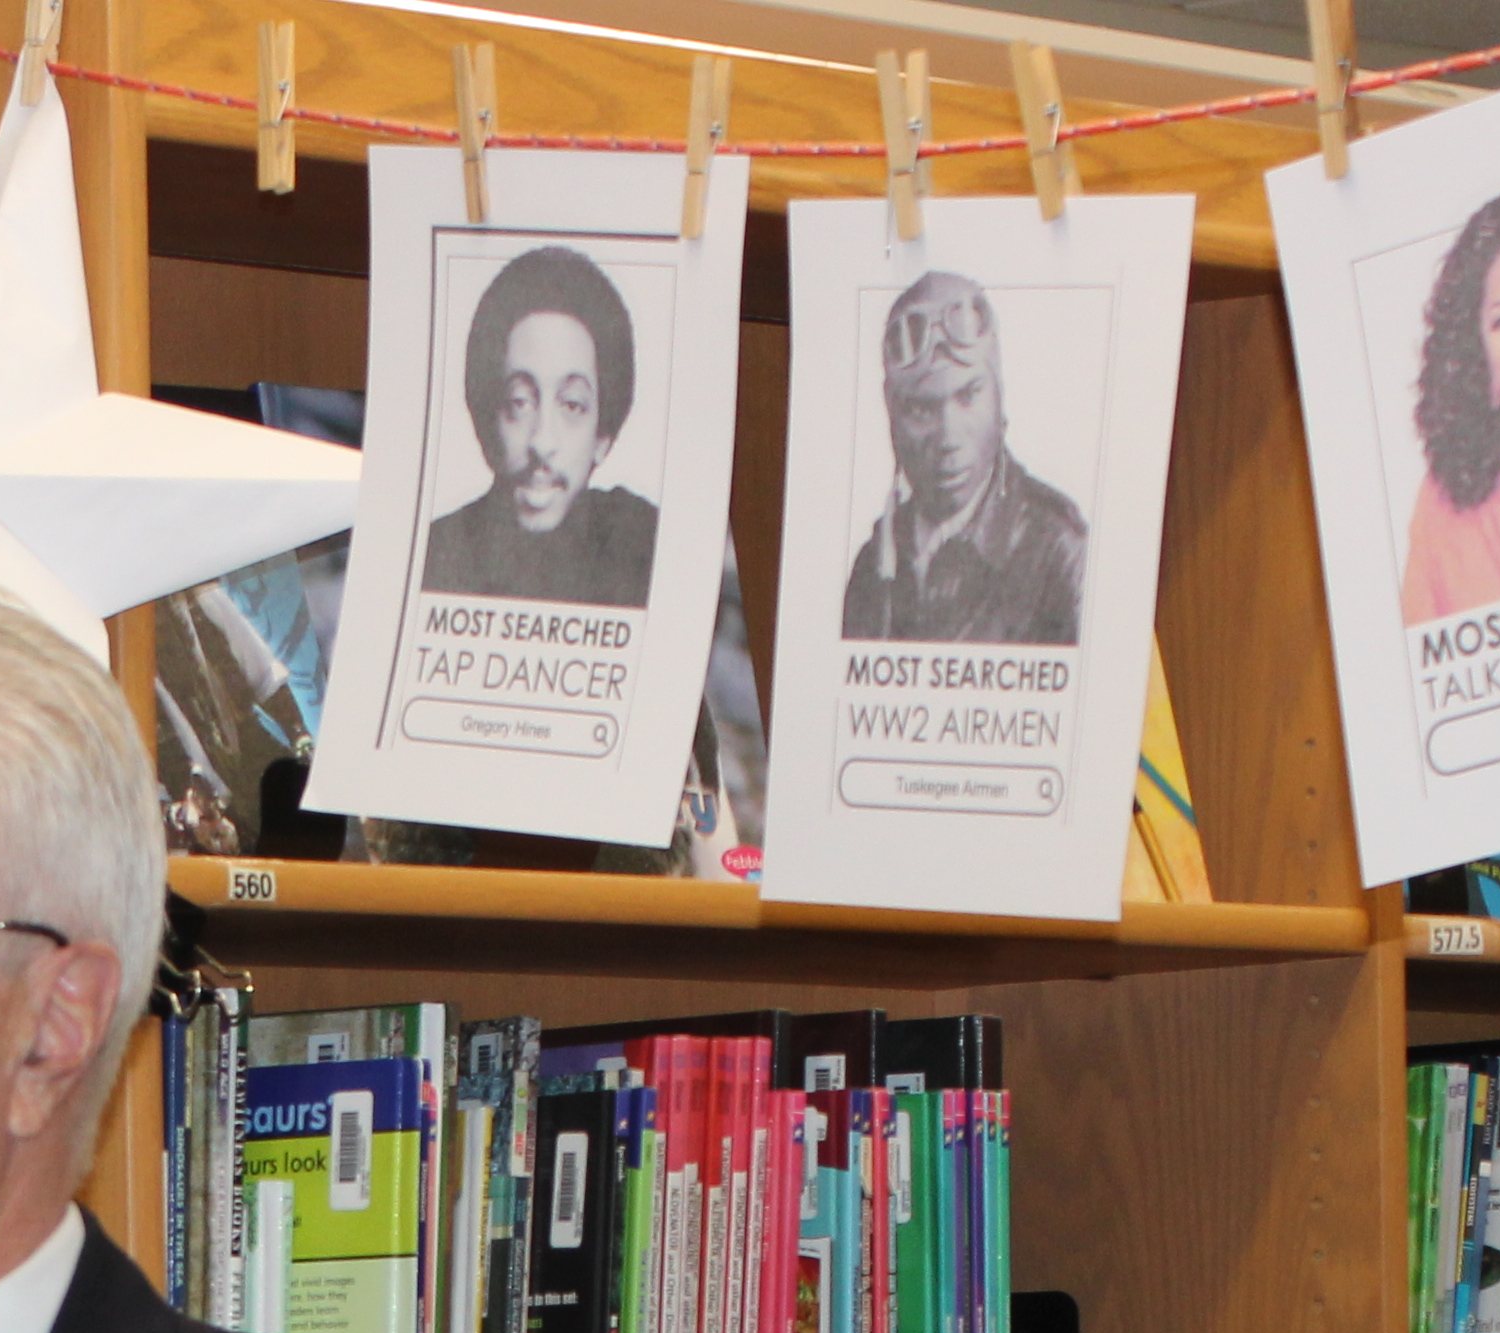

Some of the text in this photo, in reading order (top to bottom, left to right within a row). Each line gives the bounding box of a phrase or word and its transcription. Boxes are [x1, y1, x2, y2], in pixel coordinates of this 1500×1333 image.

[425, 606, 632, 649] MOST SEARCHED
[416, 647, 628, 701] TAP DANCER
[846, 655, 1069, 691] MOST SEARCHED
[462, 714, 552, 739] Gregory Hines
[849, 703, 1061, 747] WW2 AIRMEN
[896, 776, 1009, 800] Tuskegee Airmen
[232, 871, 274, 901] 560
[1433, 926, 1480, 953] 577.5
[284, 1149, 328, 1174] look
